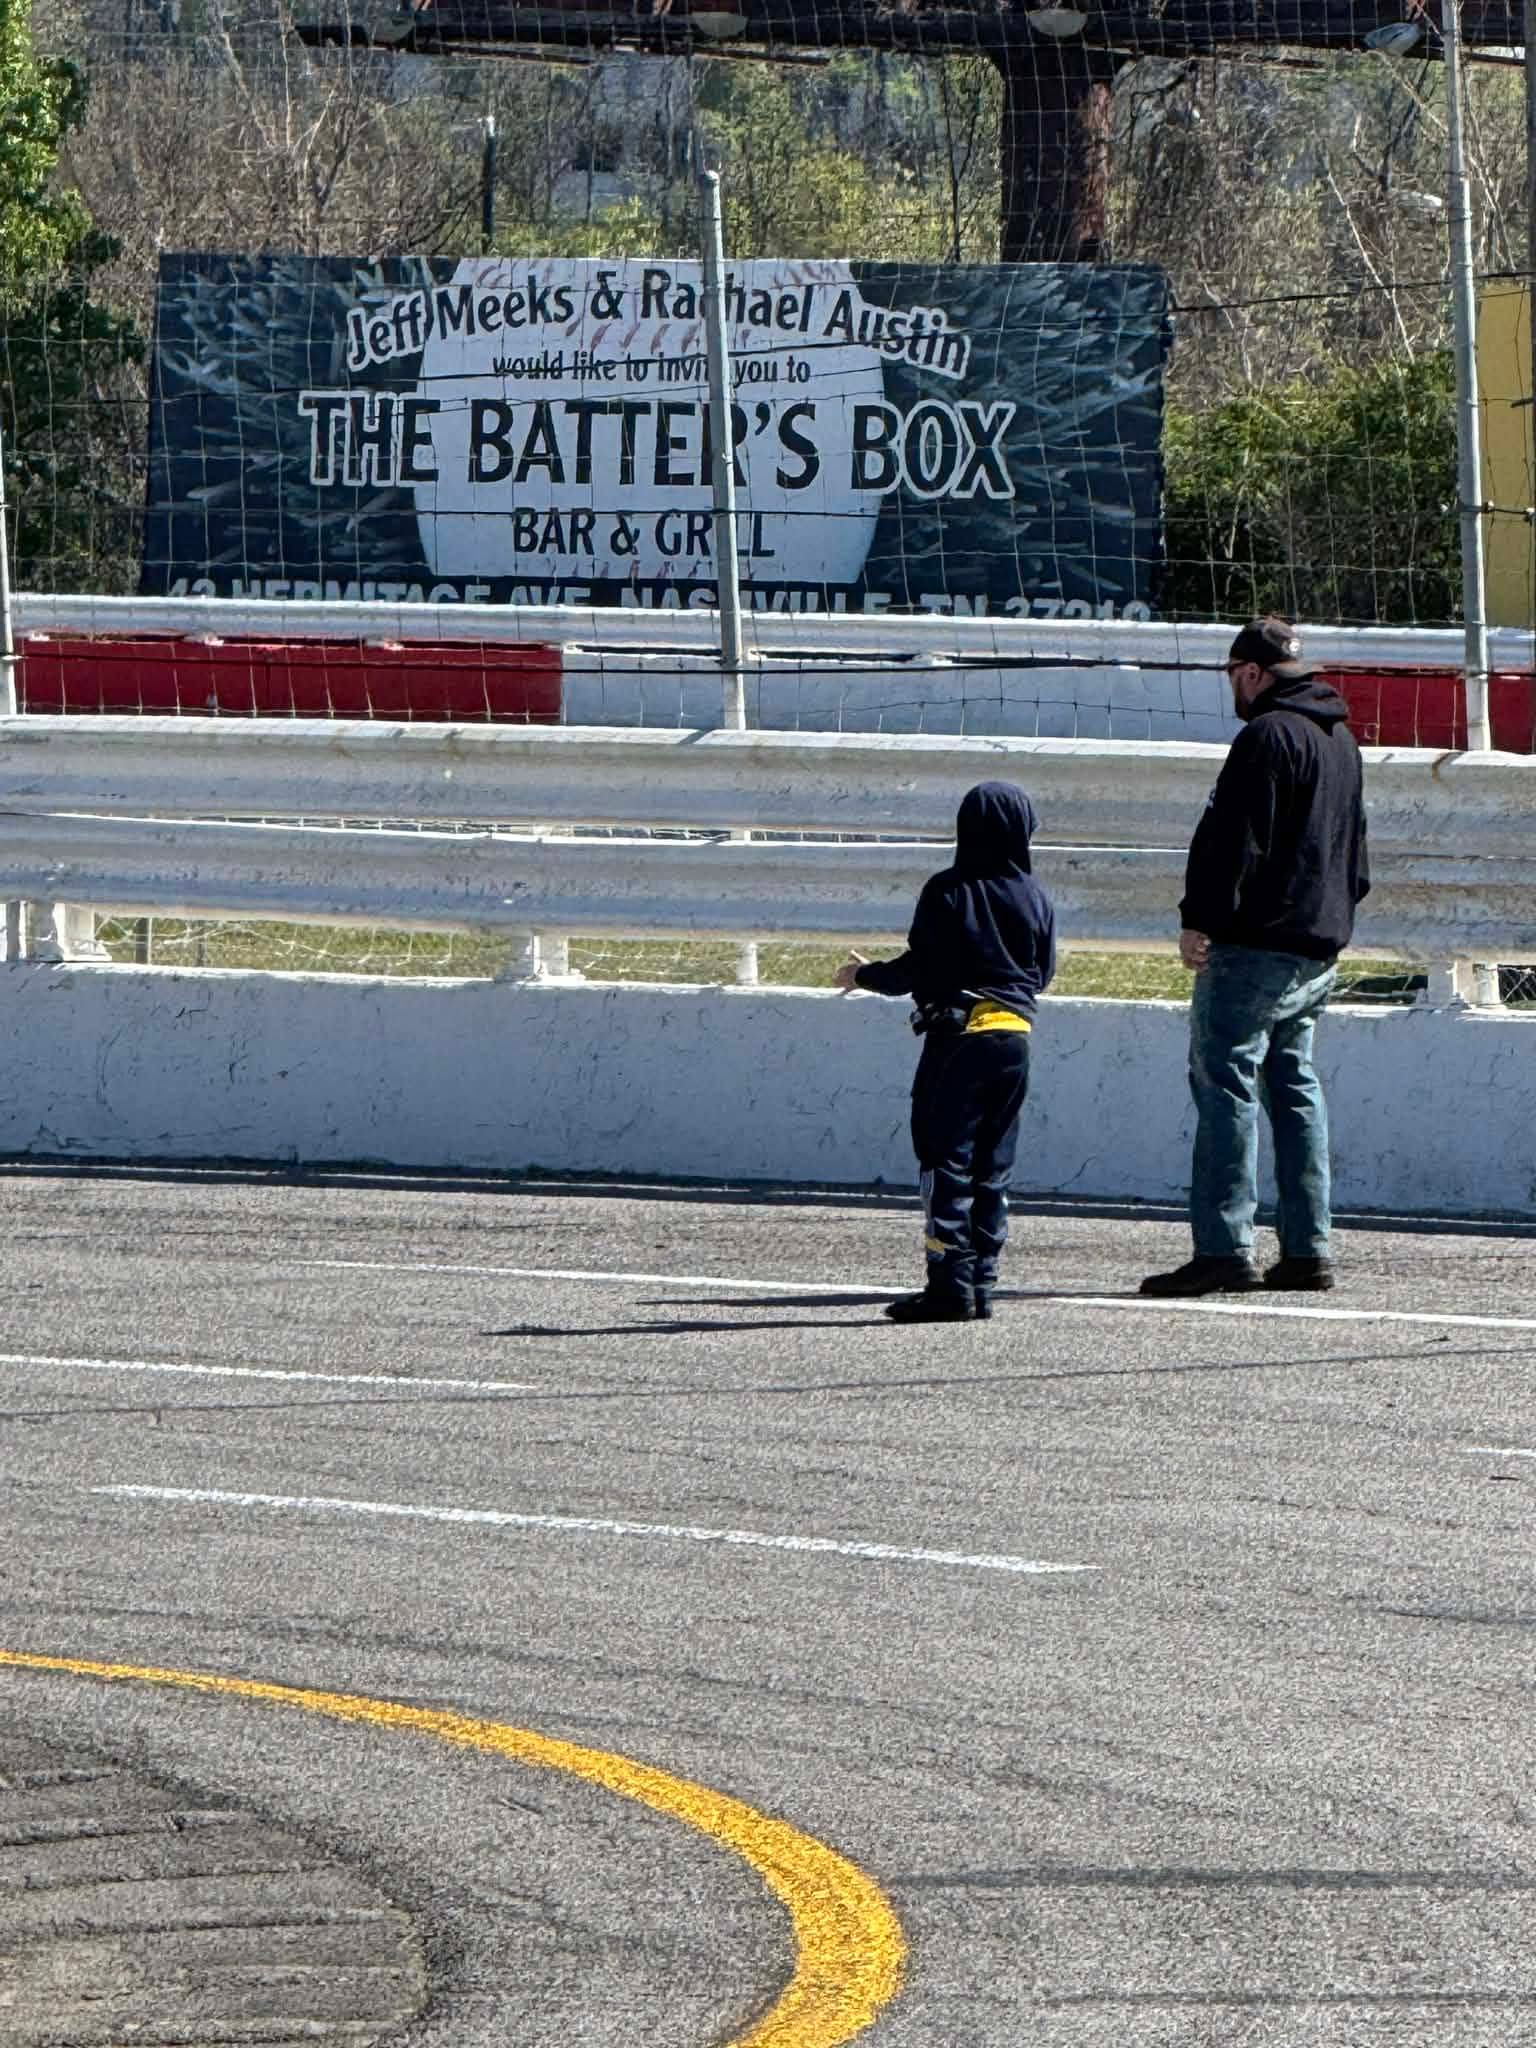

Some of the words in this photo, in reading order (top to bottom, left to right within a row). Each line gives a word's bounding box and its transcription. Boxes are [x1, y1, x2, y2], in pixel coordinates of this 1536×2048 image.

[348, 292, 424, 371] Jeff
[434, 275, 575, 340] Meeks
[590, 271, 625, 321] &
[641, 269, 813, 332] Rahael
[823, 290, 970, 377] Austin
[493, 350, 563, 380] would
[572, 350, 617, 381] like
[625, 352, 648, 382] to
[657, 350, 712, 382] invit
[733, 359, 778, 388] you
[786, 355, 812, 382] to
[298, 392, 440, 486] THE
[468, 398, 820, 489] BATTER'S
[850, 401, 1016, 498] BOX
[511, 507, 596, 555] BAR
[610, 510, 641, 556] &
[655, 509, 775, 557] GRLL
